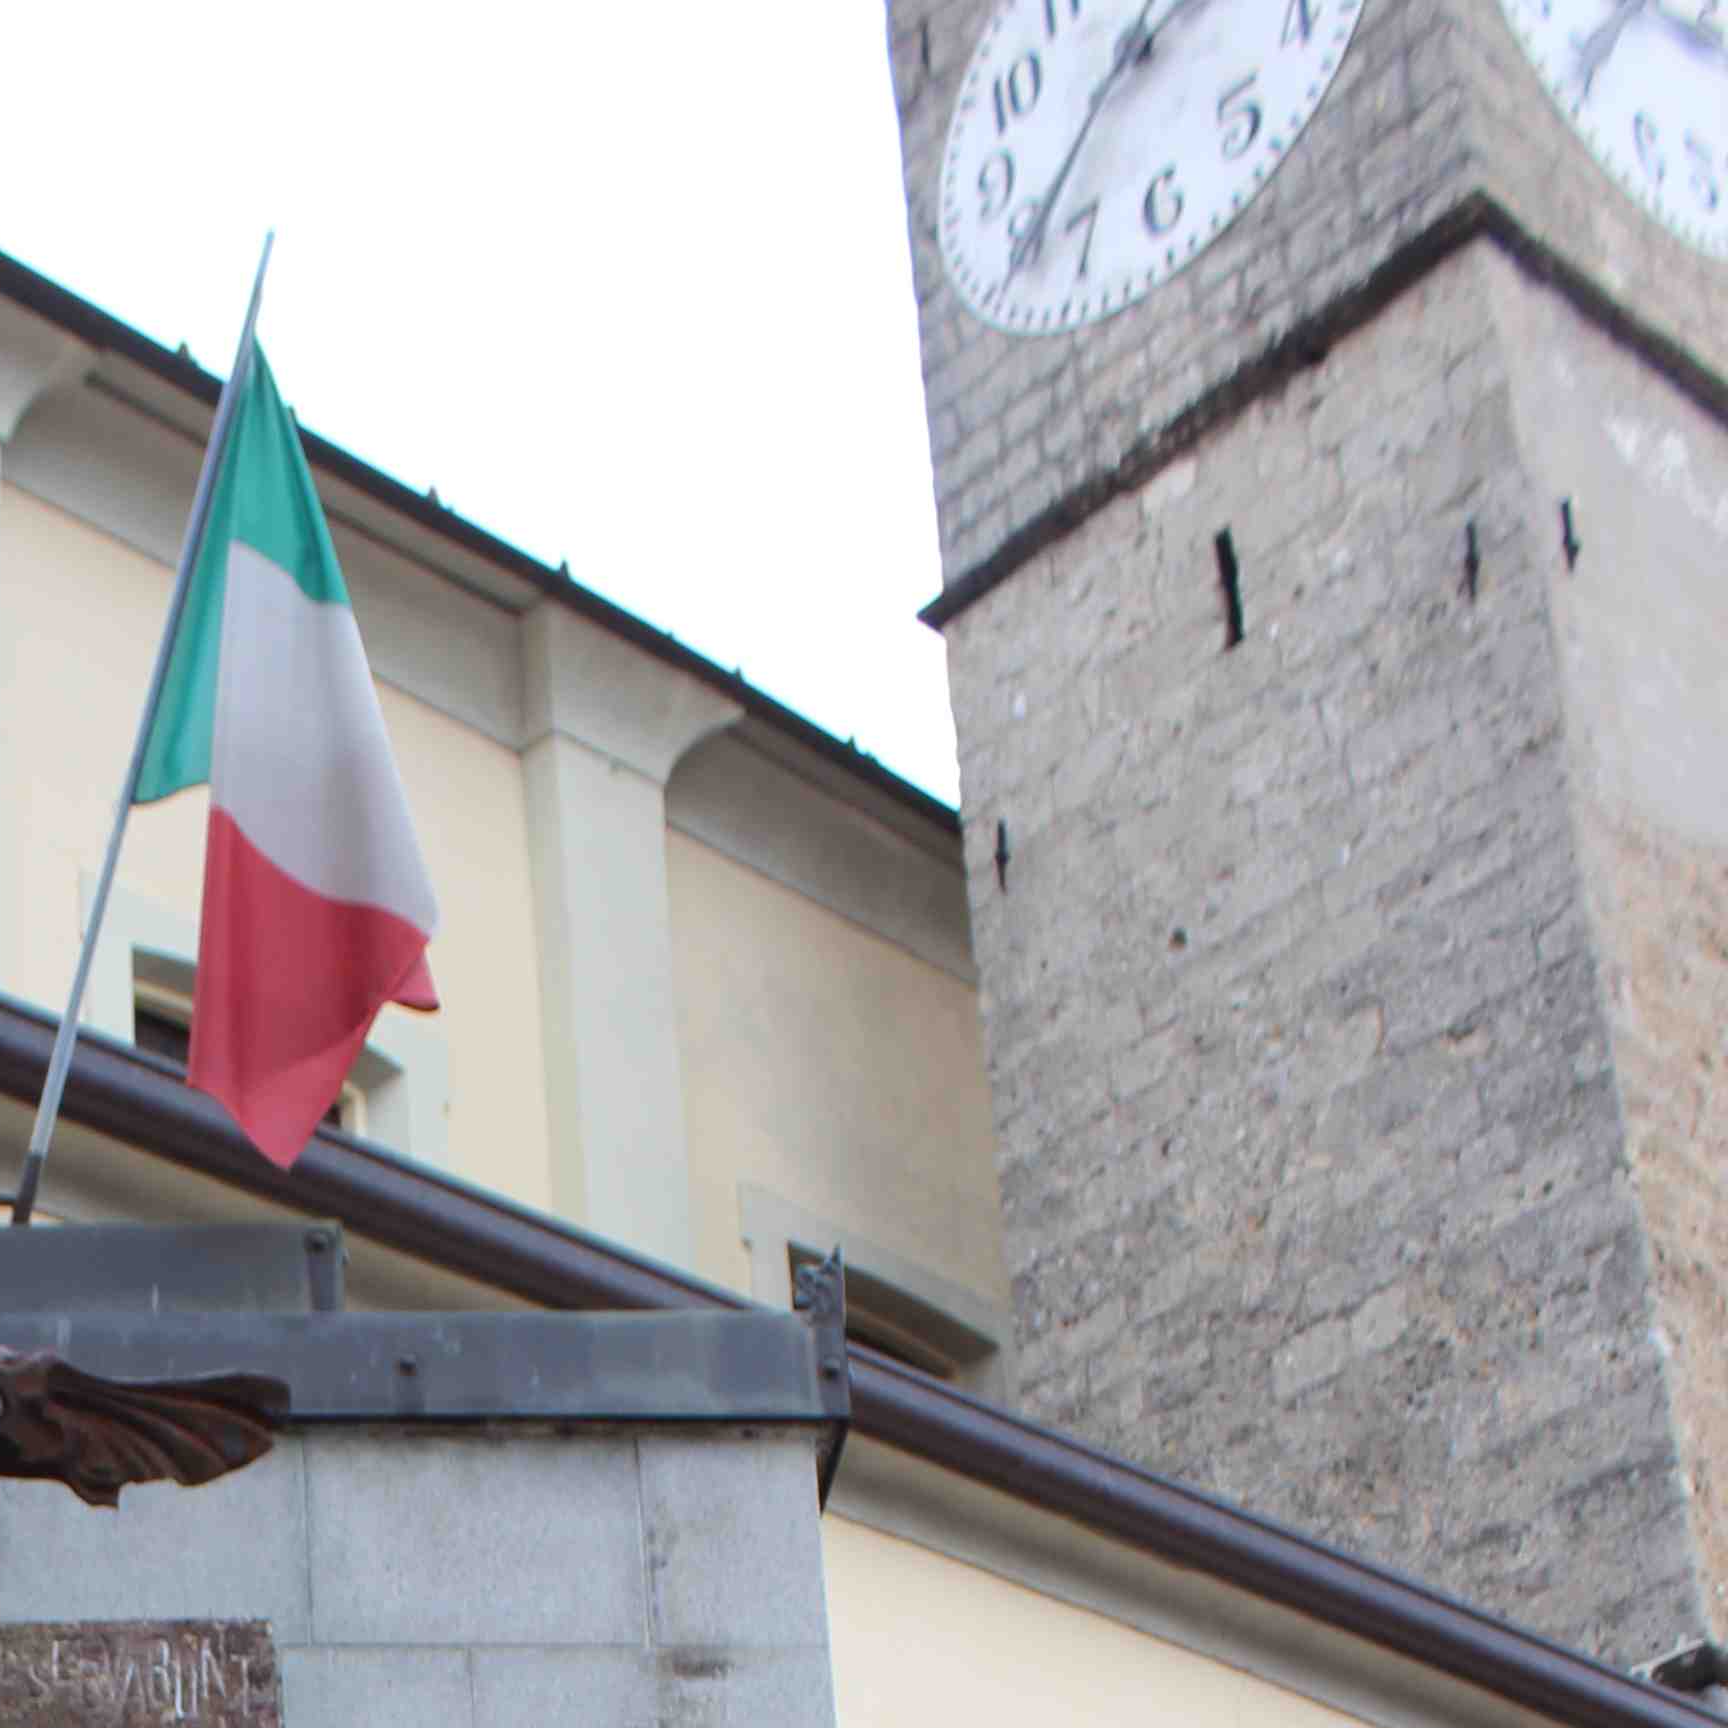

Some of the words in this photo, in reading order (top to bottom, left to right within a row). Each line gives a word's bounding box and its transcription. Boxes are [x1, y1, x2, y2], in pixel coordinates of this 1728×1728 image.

[994, 48, 1041, 137] 10
[1216, 70, 1262, 160] 5
[978, 147, 1014, 221] 9
[1144, 162, 1182, 235] 6
[1064, 197, 1099, 278] 7
